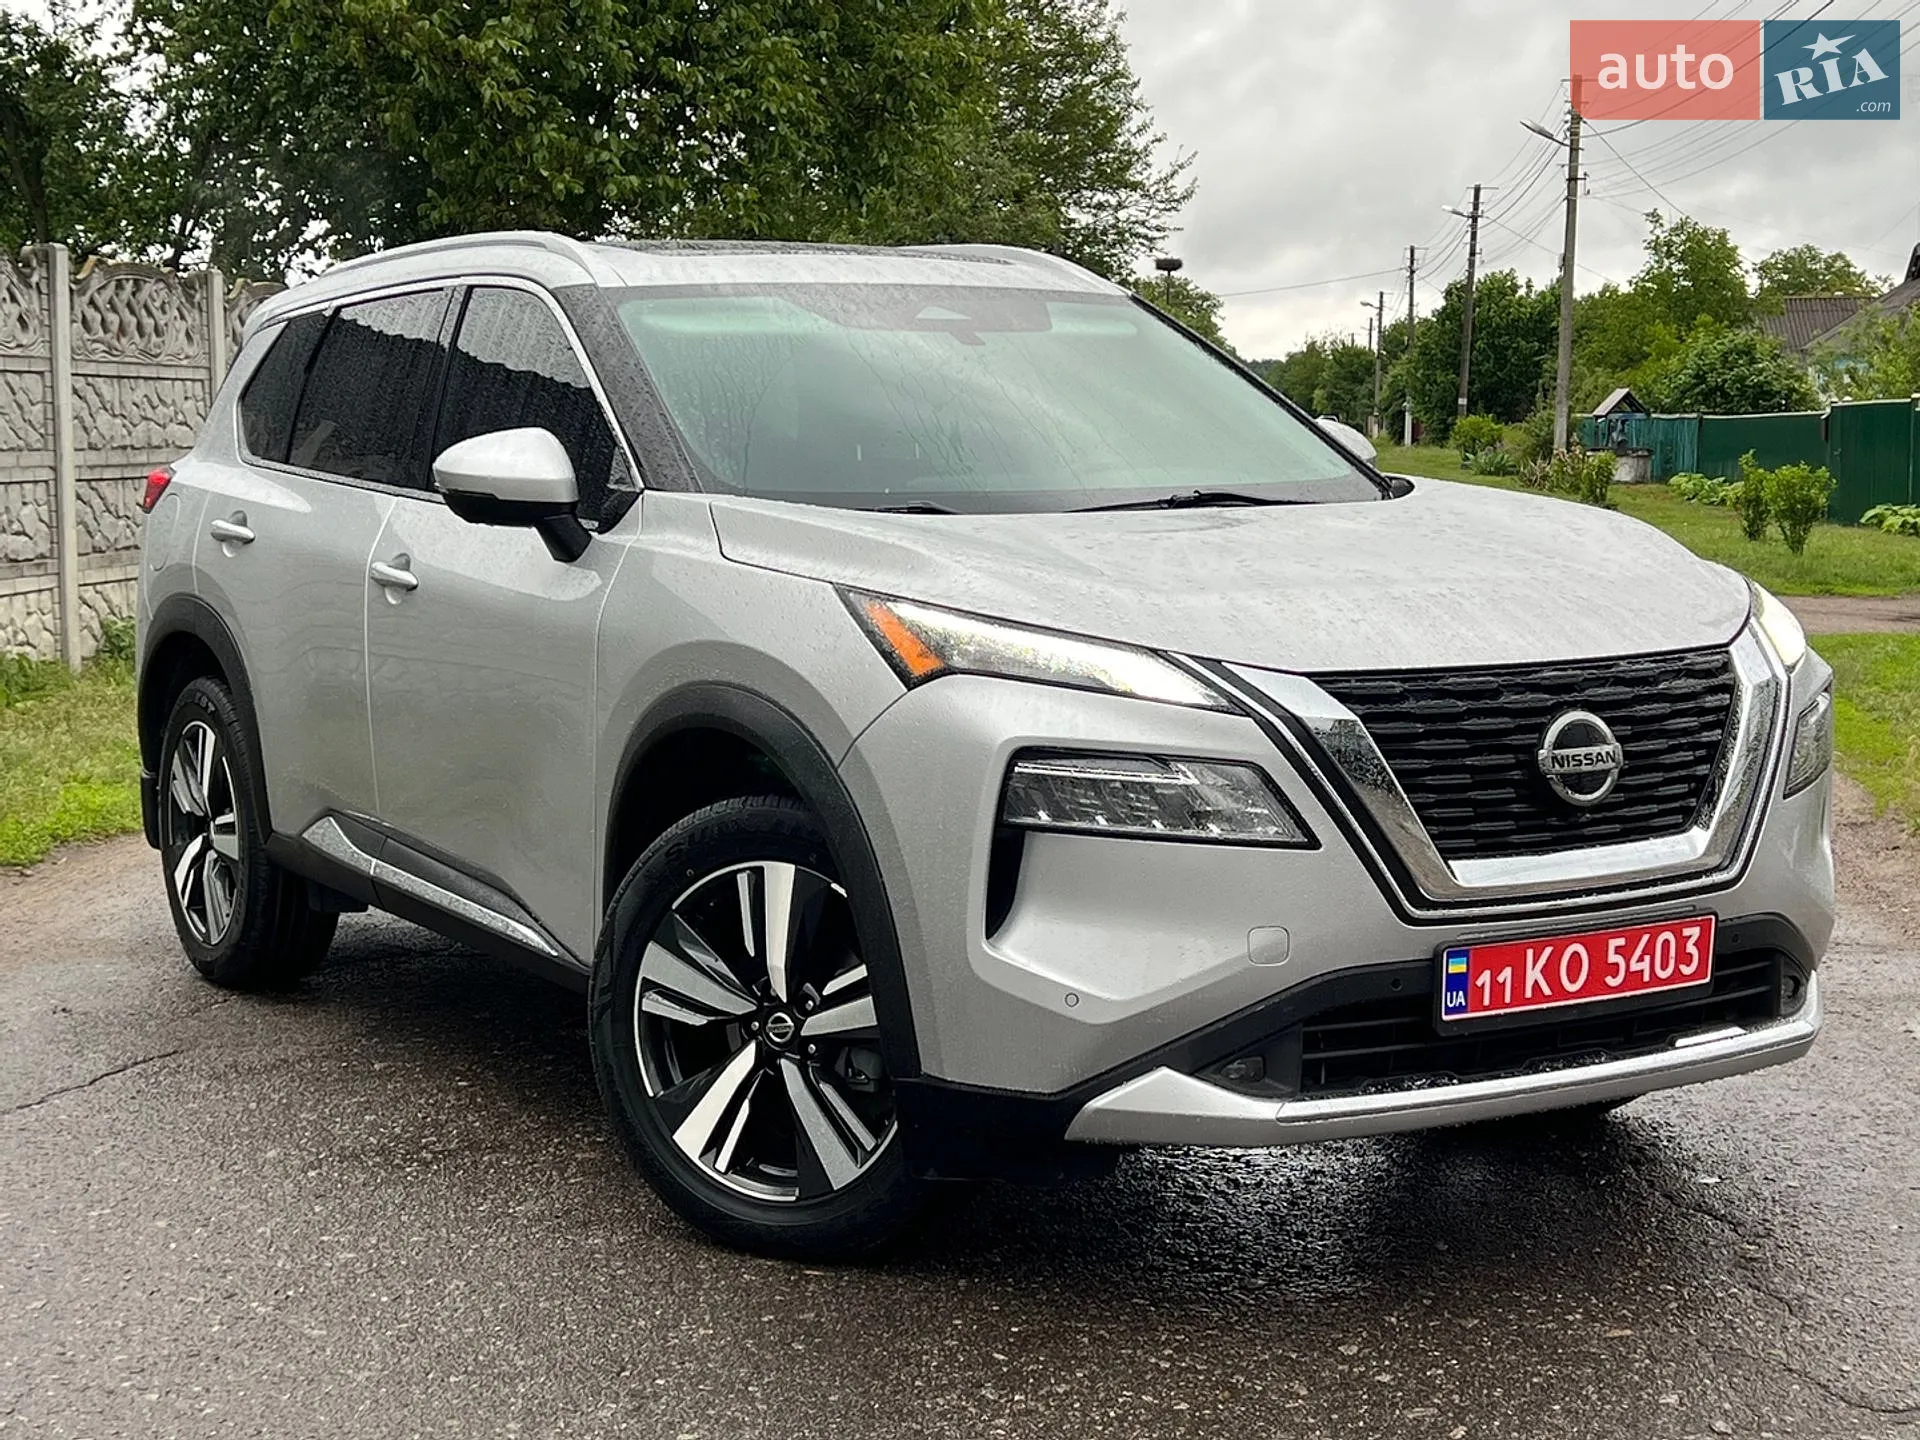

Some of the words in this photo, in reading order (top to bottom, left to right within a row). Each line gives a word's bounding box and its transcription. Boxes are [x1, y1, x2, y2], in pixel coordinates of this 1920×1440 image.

[1551, 750, 1616, 769] NISSAN
[1604, 926, 1700, 988] 5403
[1446, 991, 1466, 1007] UA
